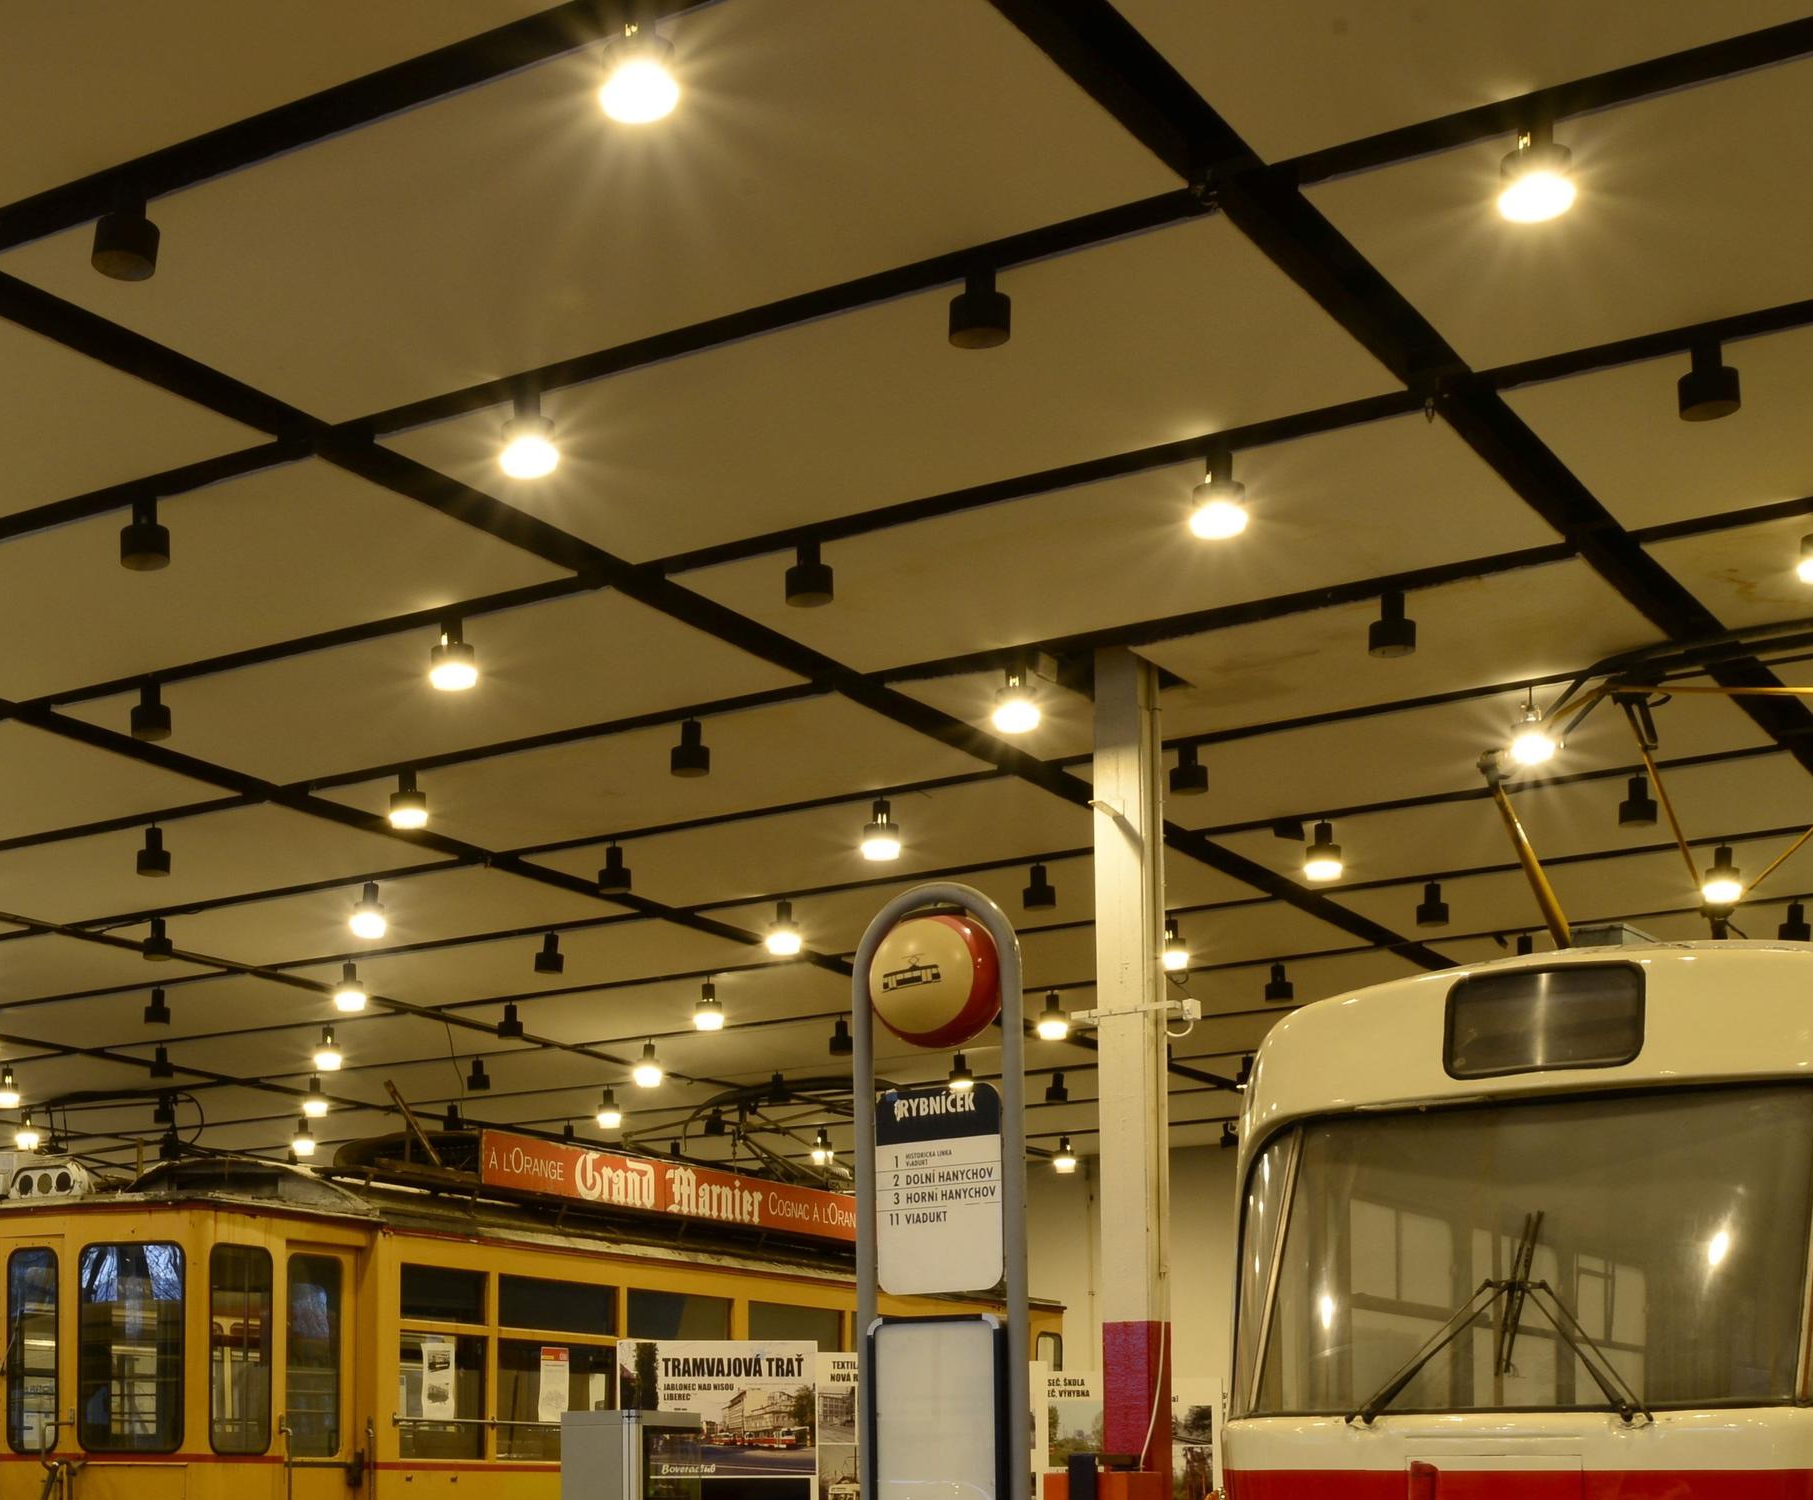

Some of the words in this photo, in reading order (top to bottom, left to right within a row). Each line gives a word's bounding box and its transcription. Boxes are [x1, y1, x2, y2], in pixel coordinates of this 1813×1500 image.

[894, 1156, 899, 1168] 1
[893, 1175, 899, 1187] 2
[905, 1169, 936, 1186] DOLNÍ
[939, 1167, 994, 1183] HANYCHOV
[489, 1147, 499, 1170] À
[574, 1153, 655, 1209] Grand
[665, 1166, 763, 1224] Marnier
[768, 1192, 809, 1221] COGNAC
[893, 1193, 900, 1205] 3
[941, 1186, 996, 1201] HANYCHOV
[890, 1213, 899, 1225] 11
[905, 1211, 948, 1224] VIADUKT
[662, 1354, 762, 1377] TRAMVAJOVÁ
[765, 1354, 804, 1377] TRAŤ
[830, 1372, 851, 1382] NOVÁ
[664, 1393, 691, 1401] LIBEREC
[1059, 1388, 1090, 1398] VÝHYBNA
